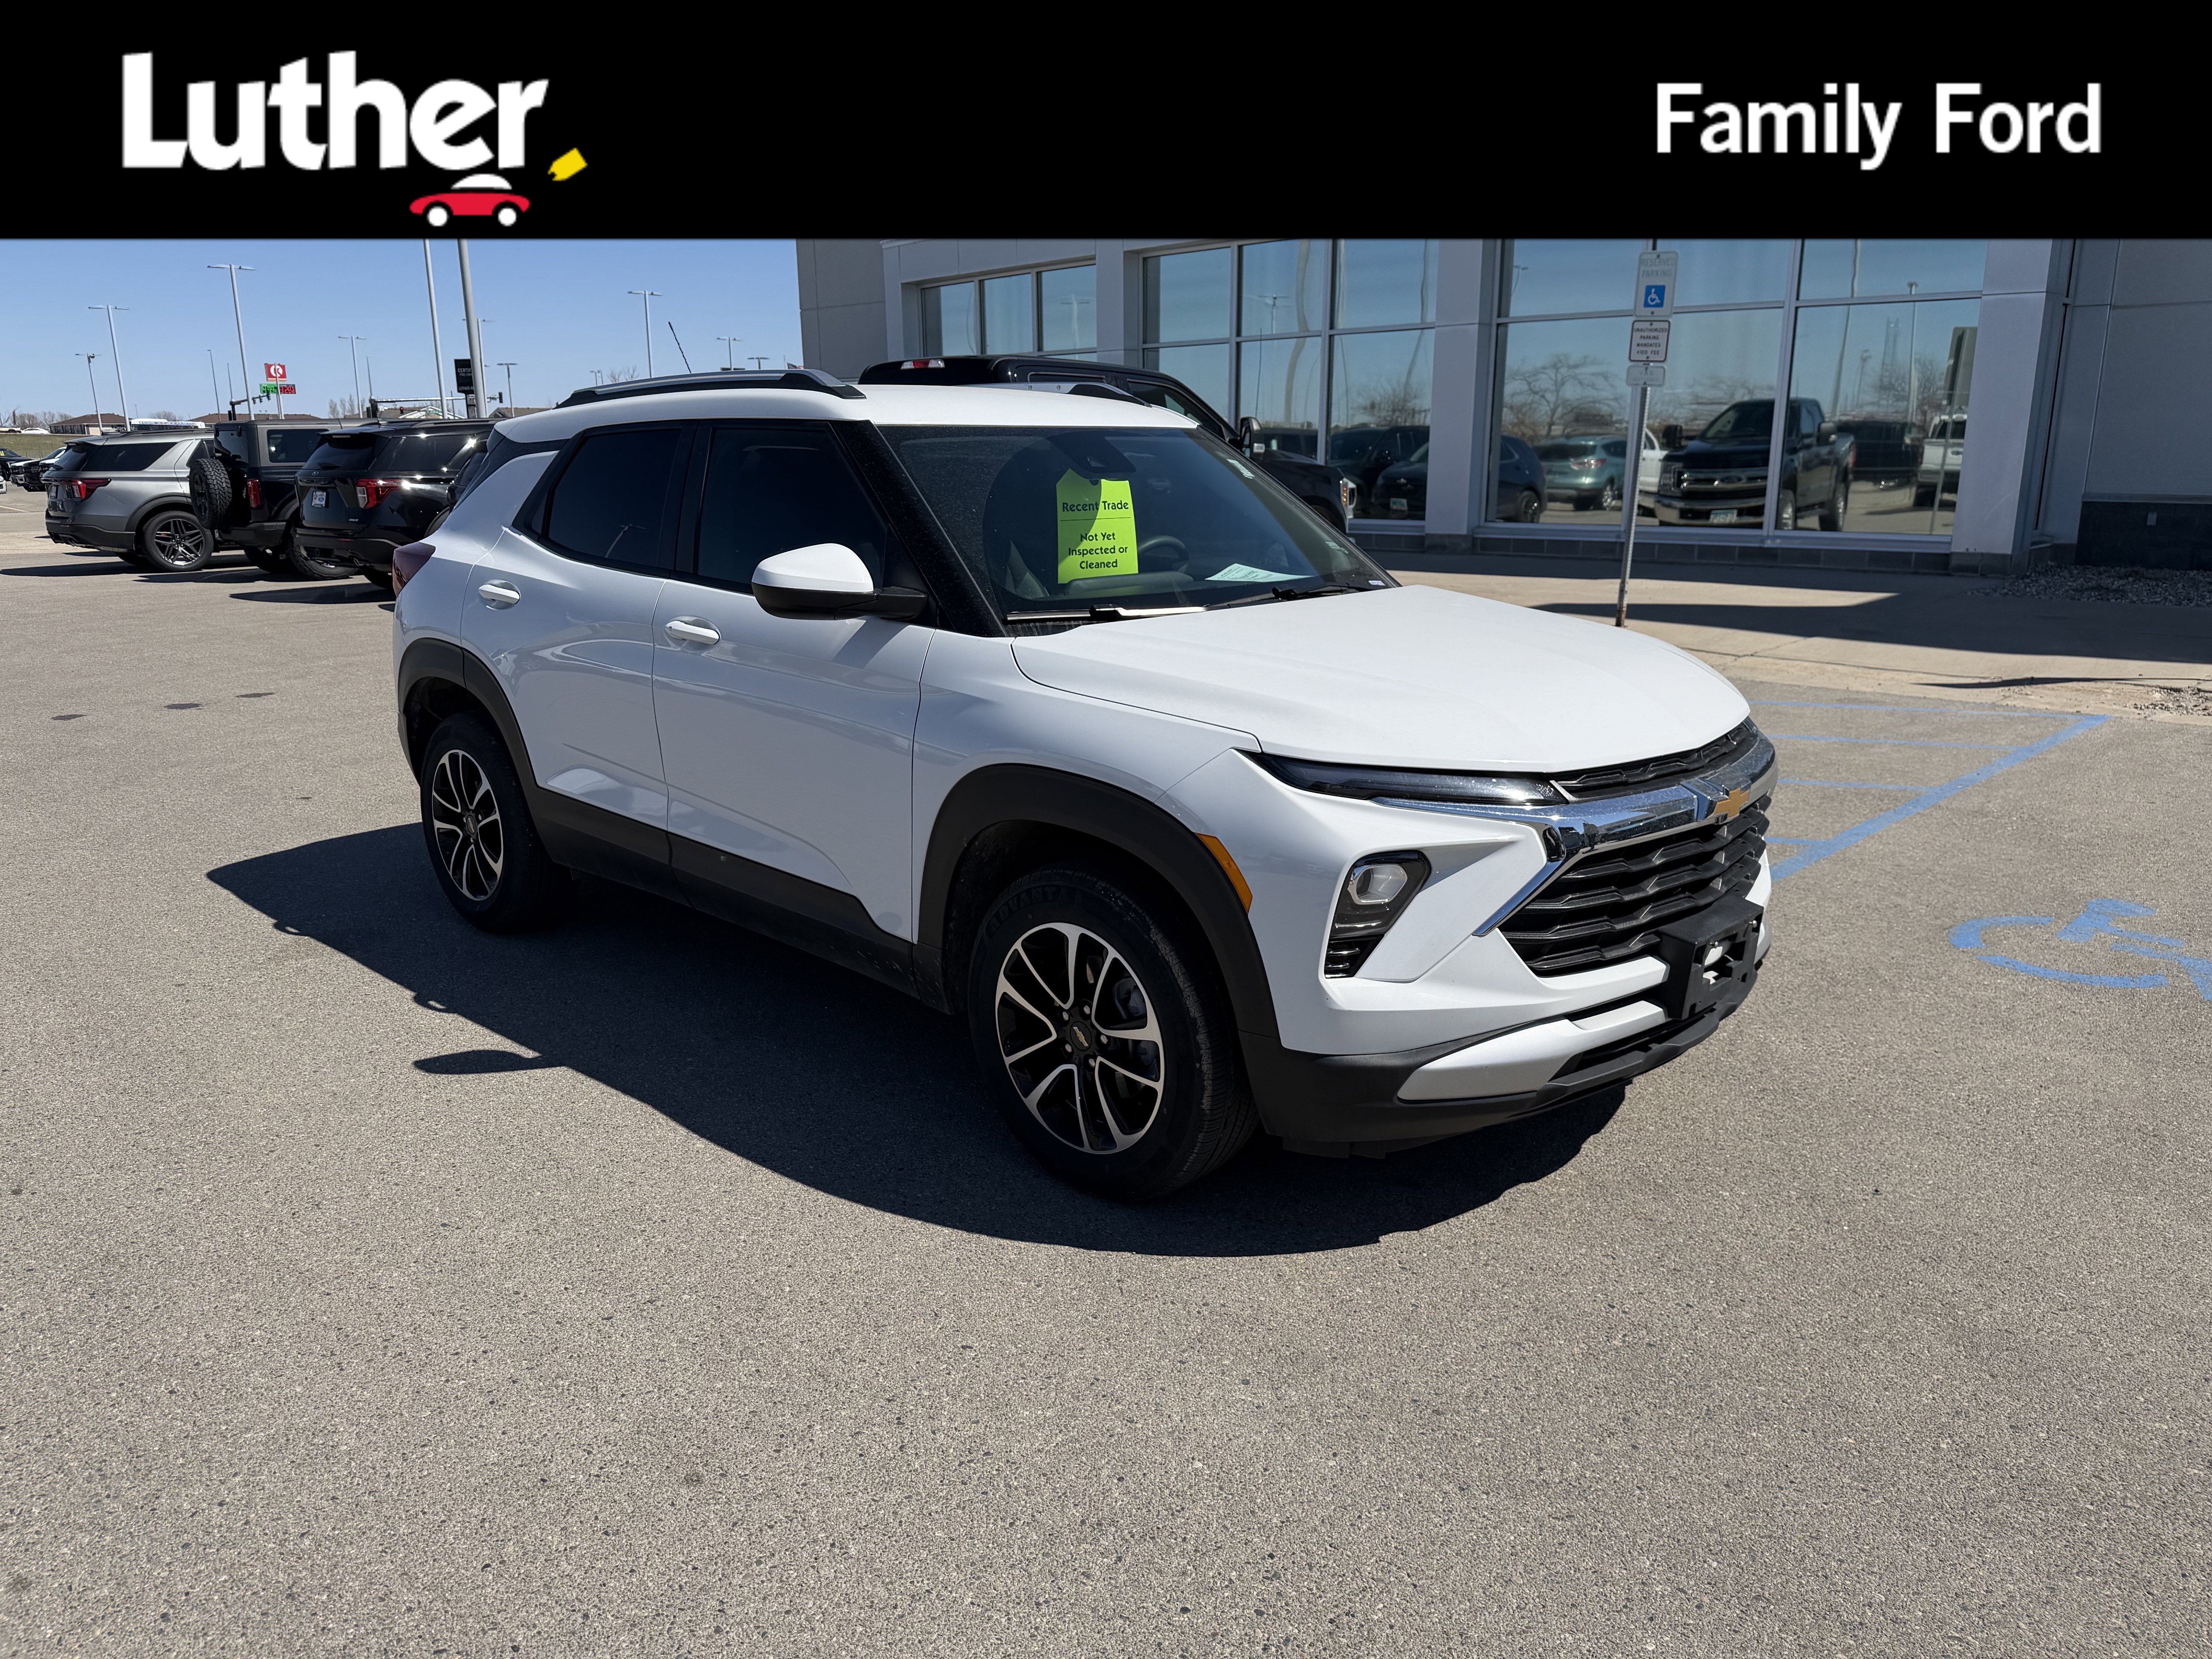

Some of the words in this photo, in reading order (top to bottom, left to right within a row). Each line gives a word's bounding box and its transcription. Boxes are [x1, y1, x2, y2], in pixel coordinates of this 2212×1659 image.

[1642, 269, 1671, 278] PARKING
[1062, 501, 1099, 512] Recent
[1102, 500, 1129, 510] Trade
[1080, 533, 1098, 542] Not
[1101, 532, 1116, 541] Yet
[1068, 545, 1115, 557] Inspected
[1080, 559, 1118, 569] Cleaned
[988, 886, 1069, 936] ADVANTA
